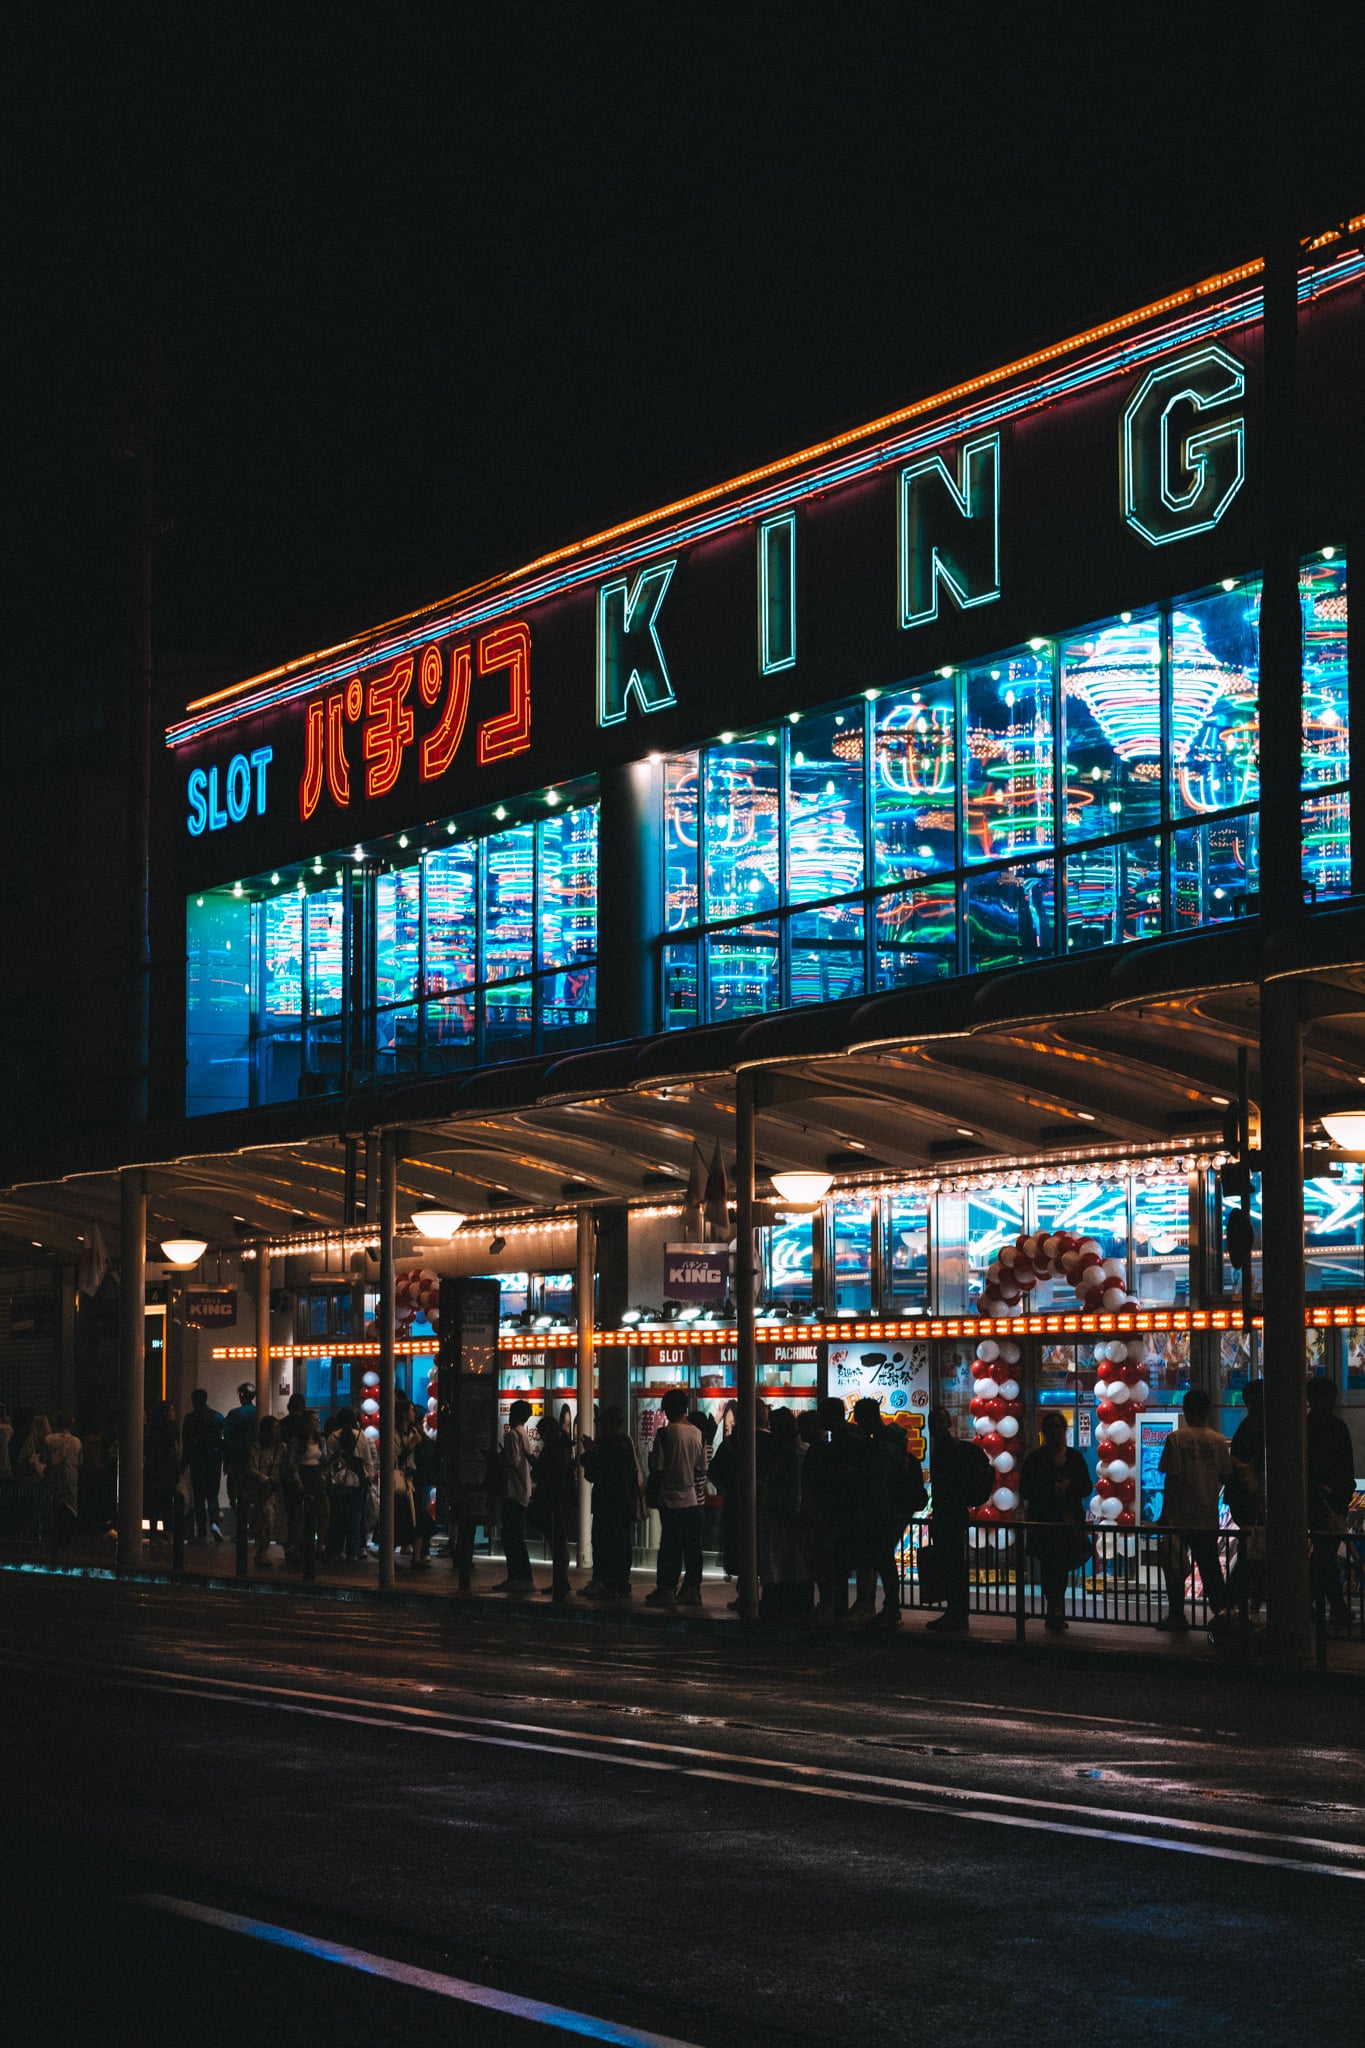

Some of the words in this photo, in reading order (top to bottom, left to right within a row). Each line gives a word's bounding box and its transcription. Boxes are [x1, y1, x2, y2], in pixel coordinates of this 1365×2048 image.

[187, 745, 273, 836] SLOT
[302, 619, 532, 822] パチンコ
[597, 342, 1247, 728] KING
[682, 1261, 709, 1269] パチンコ
[669, 1269, 721, 1283] KING
[190, 1305, 232, 1315] KING
[659, 1349, 685, 1362] SLOT
[720, 1348, 738, 1361] KIN
